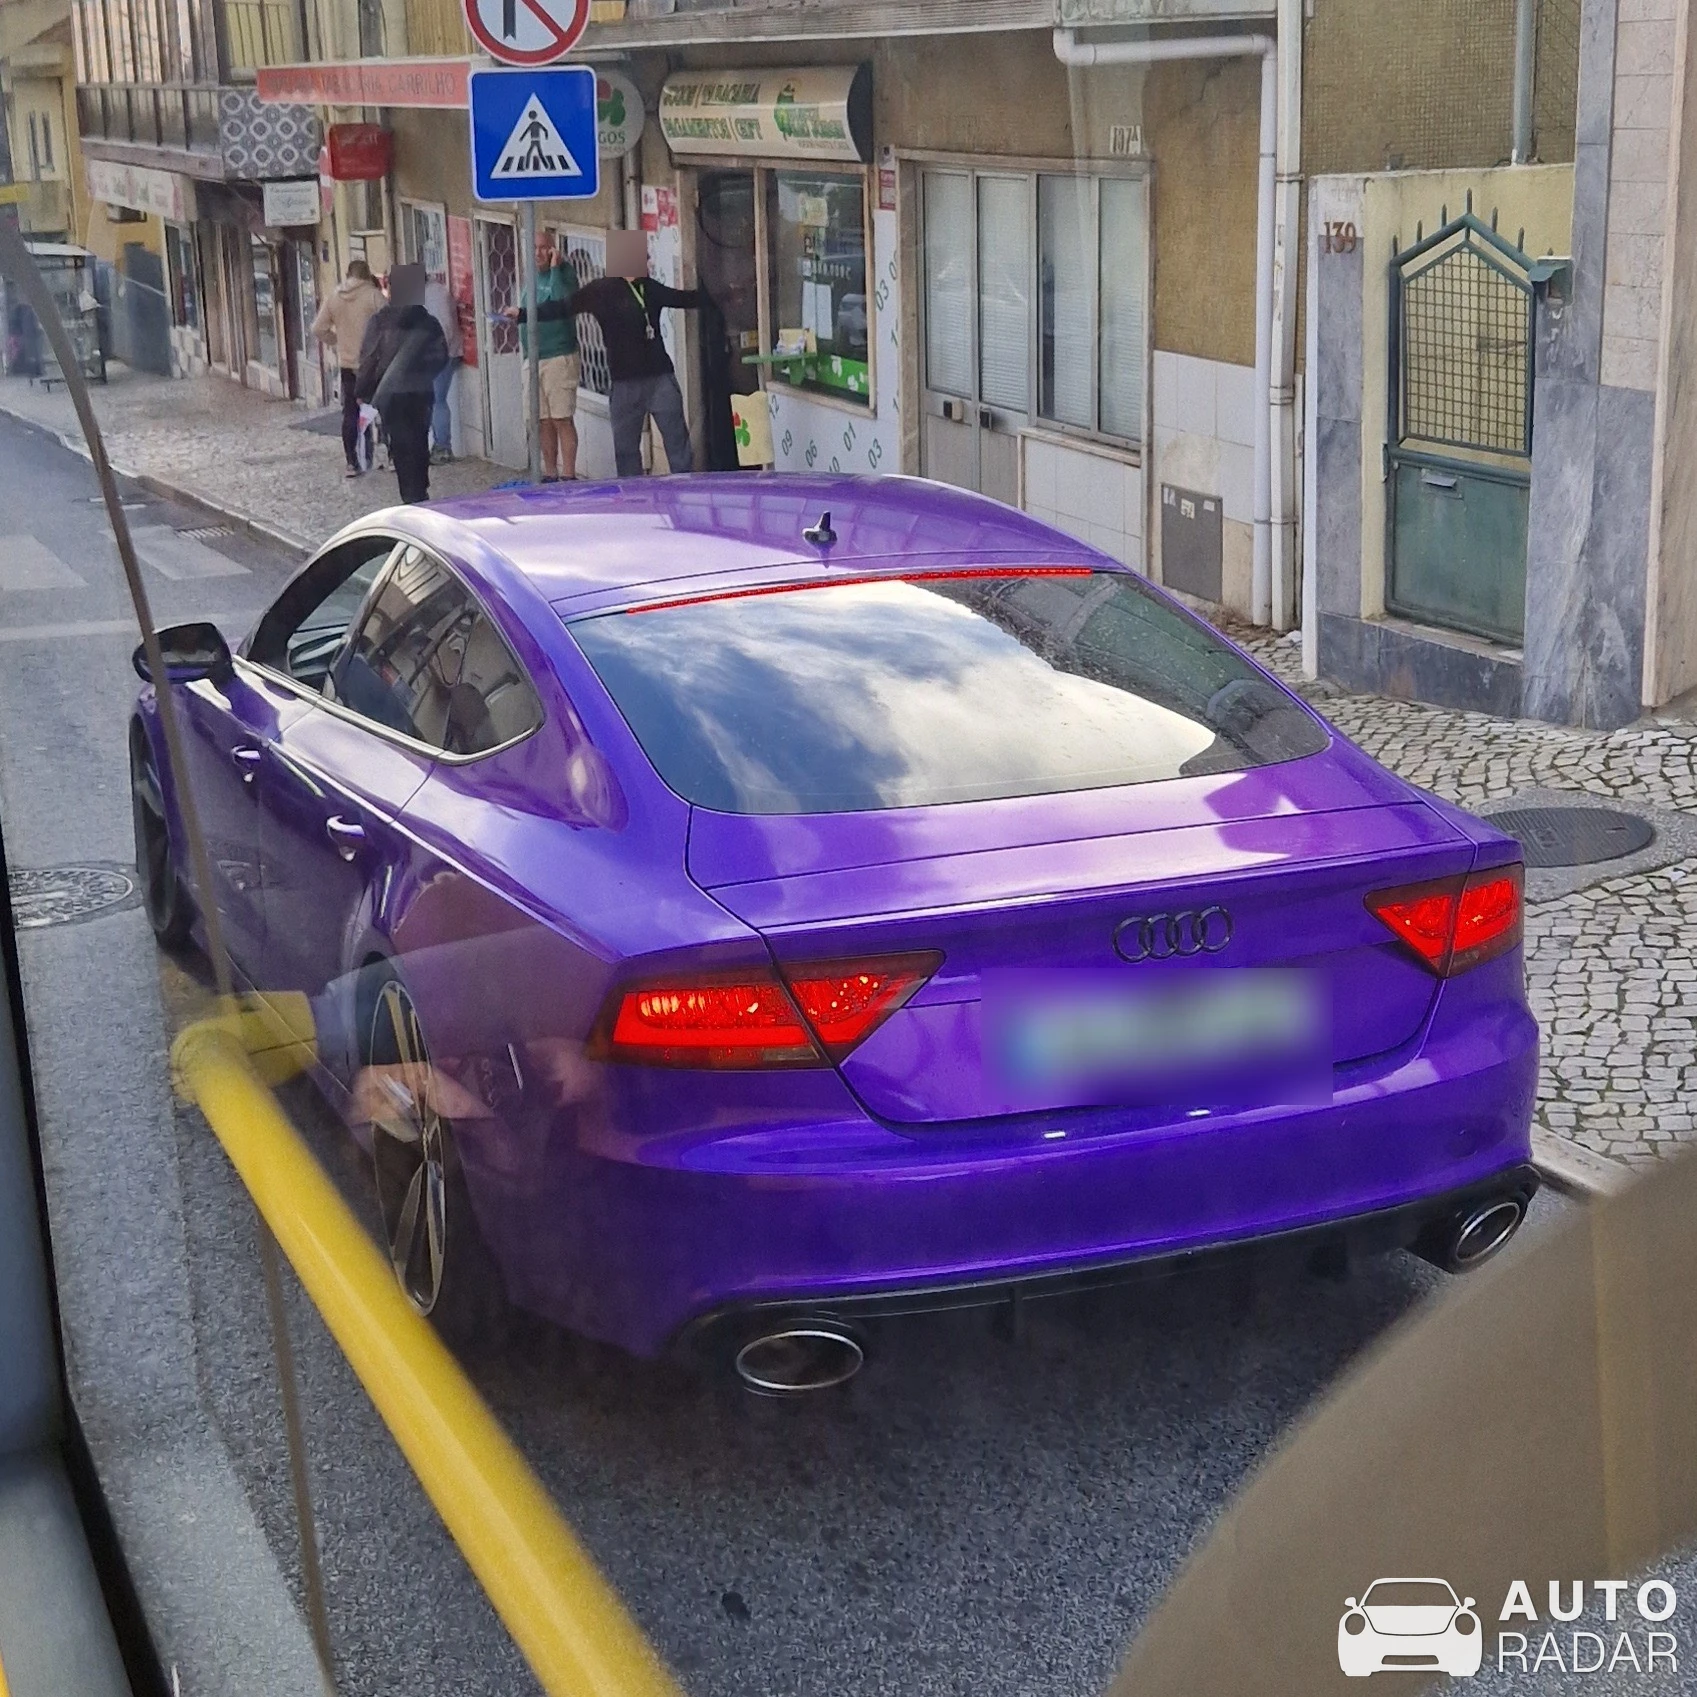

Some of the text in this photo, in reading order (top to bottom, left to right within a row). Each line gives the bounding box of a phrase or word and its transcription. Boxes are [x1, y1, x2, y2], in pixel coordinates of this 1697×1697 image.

[1323, 221, 1356, 254] 139
[875, 279, 889, 312] 03
[781, 429, 793, 456] 09
[843, 421, 856, 451] 01
[806, 440, 817, 467] 06
[868, 438, 882, 469] 03
